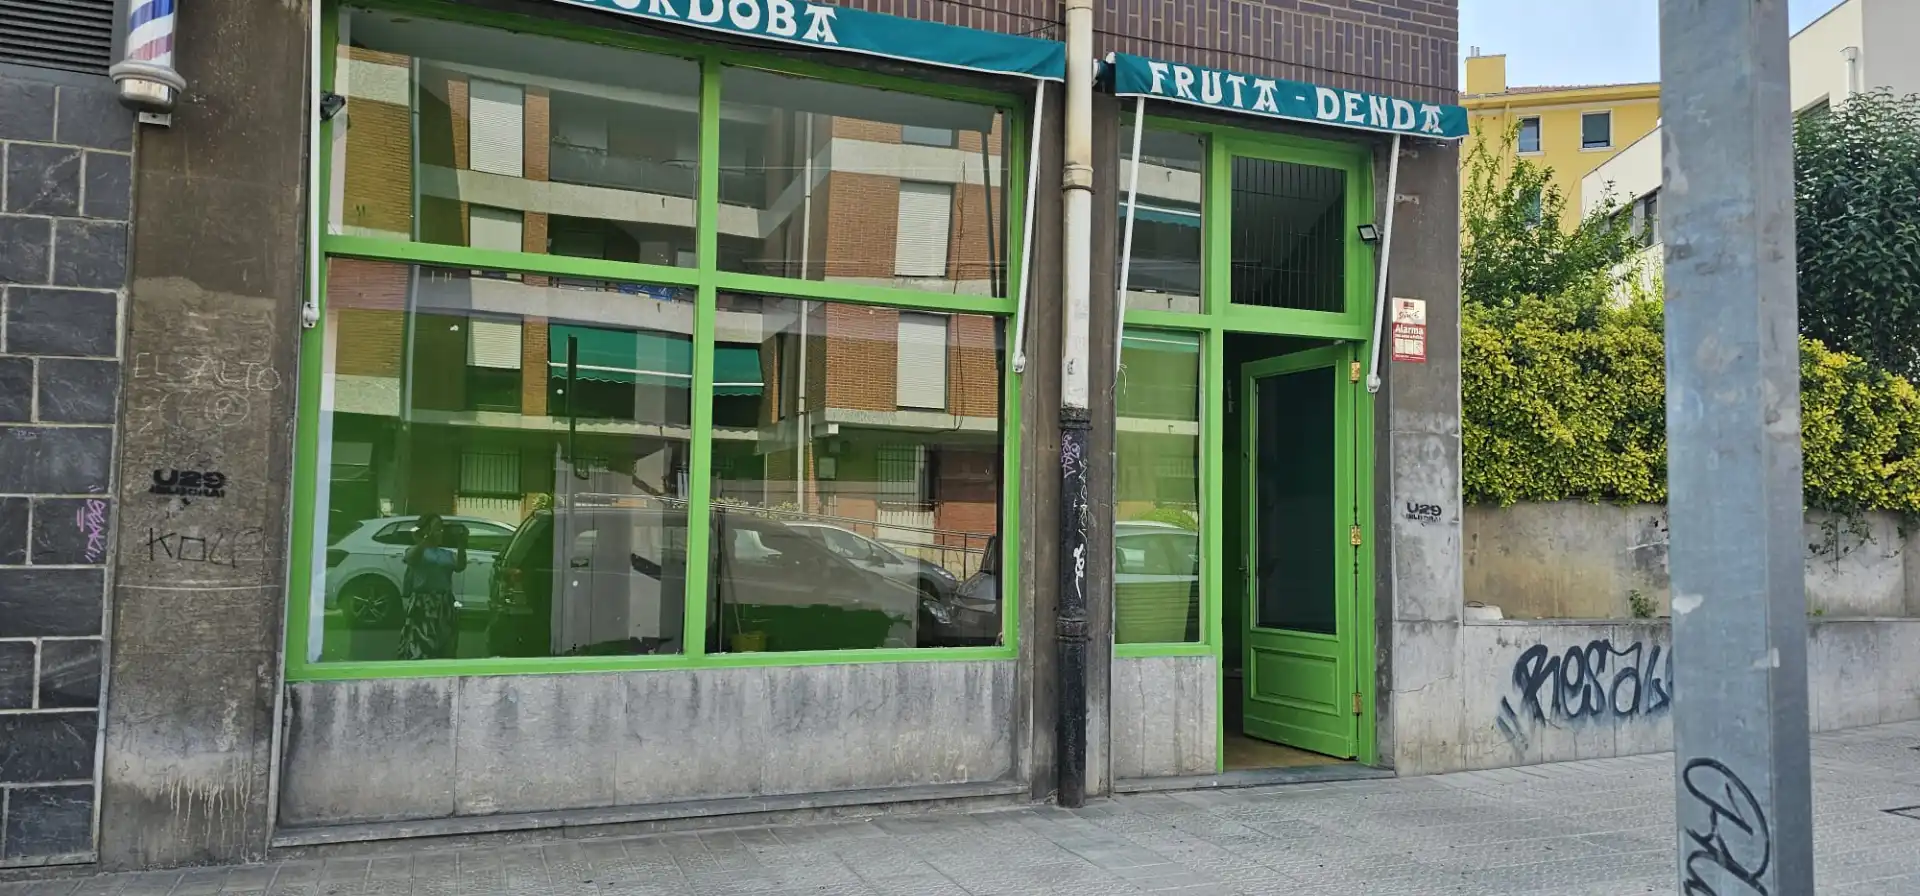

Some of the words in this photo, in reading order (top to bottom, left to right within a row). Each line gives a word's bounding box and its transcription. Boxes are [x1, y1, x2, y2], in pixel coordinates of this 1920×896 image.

[1148, 61, 1280, 113] FRUTA
[1315, 86, 1444, 134] DENDA
[1394, 324, 1424, 335] Alarma
[153, 469, 226, 488] U29
[1406, 501, 1442, 516] U29
